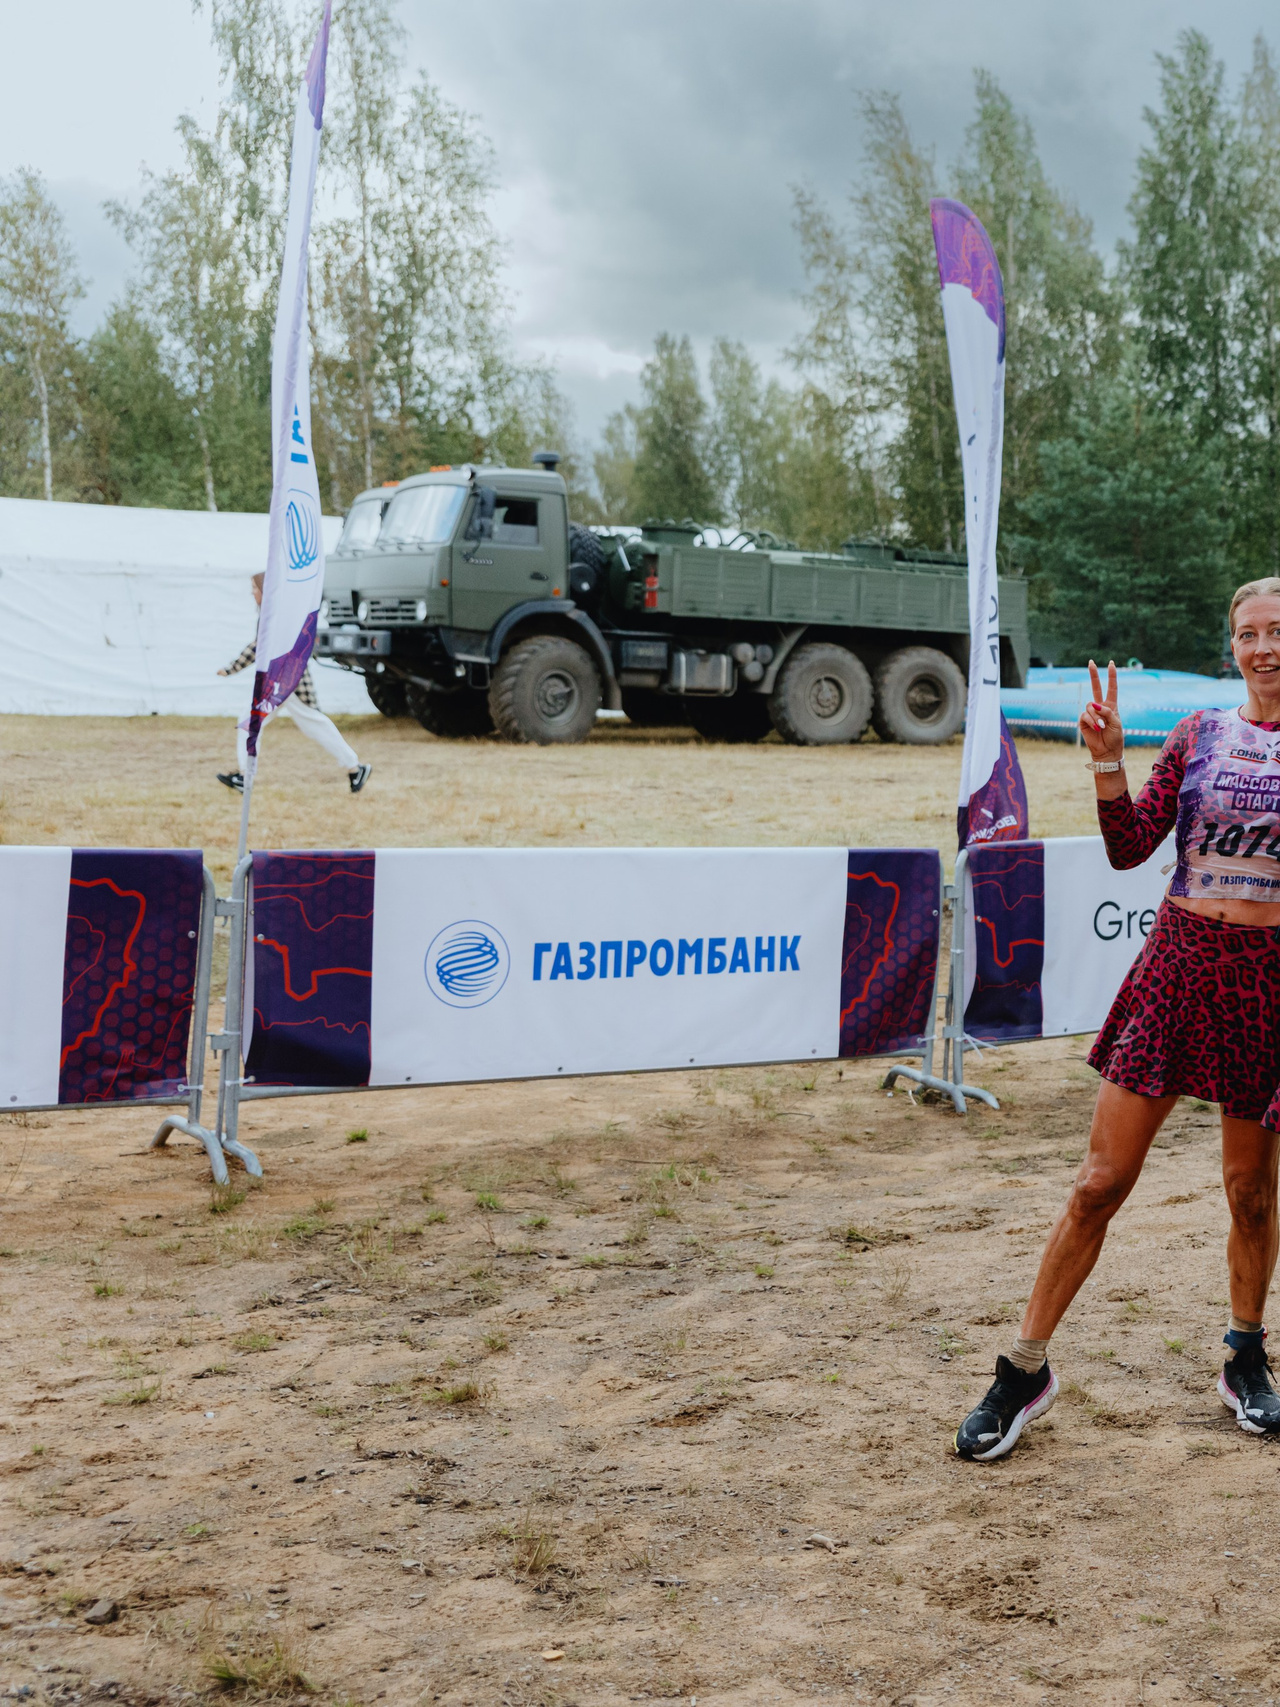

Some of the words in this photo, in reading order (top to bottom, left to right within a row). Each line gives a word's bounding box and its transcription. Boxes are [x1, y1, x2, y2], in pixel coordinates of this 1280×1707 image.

[1230, 748, 1268, 761] ГОНКА
[1234, 792, 1280, 811] СТАРТ
[532, 935, 802, 981] ГАЗПРОМБАНК
